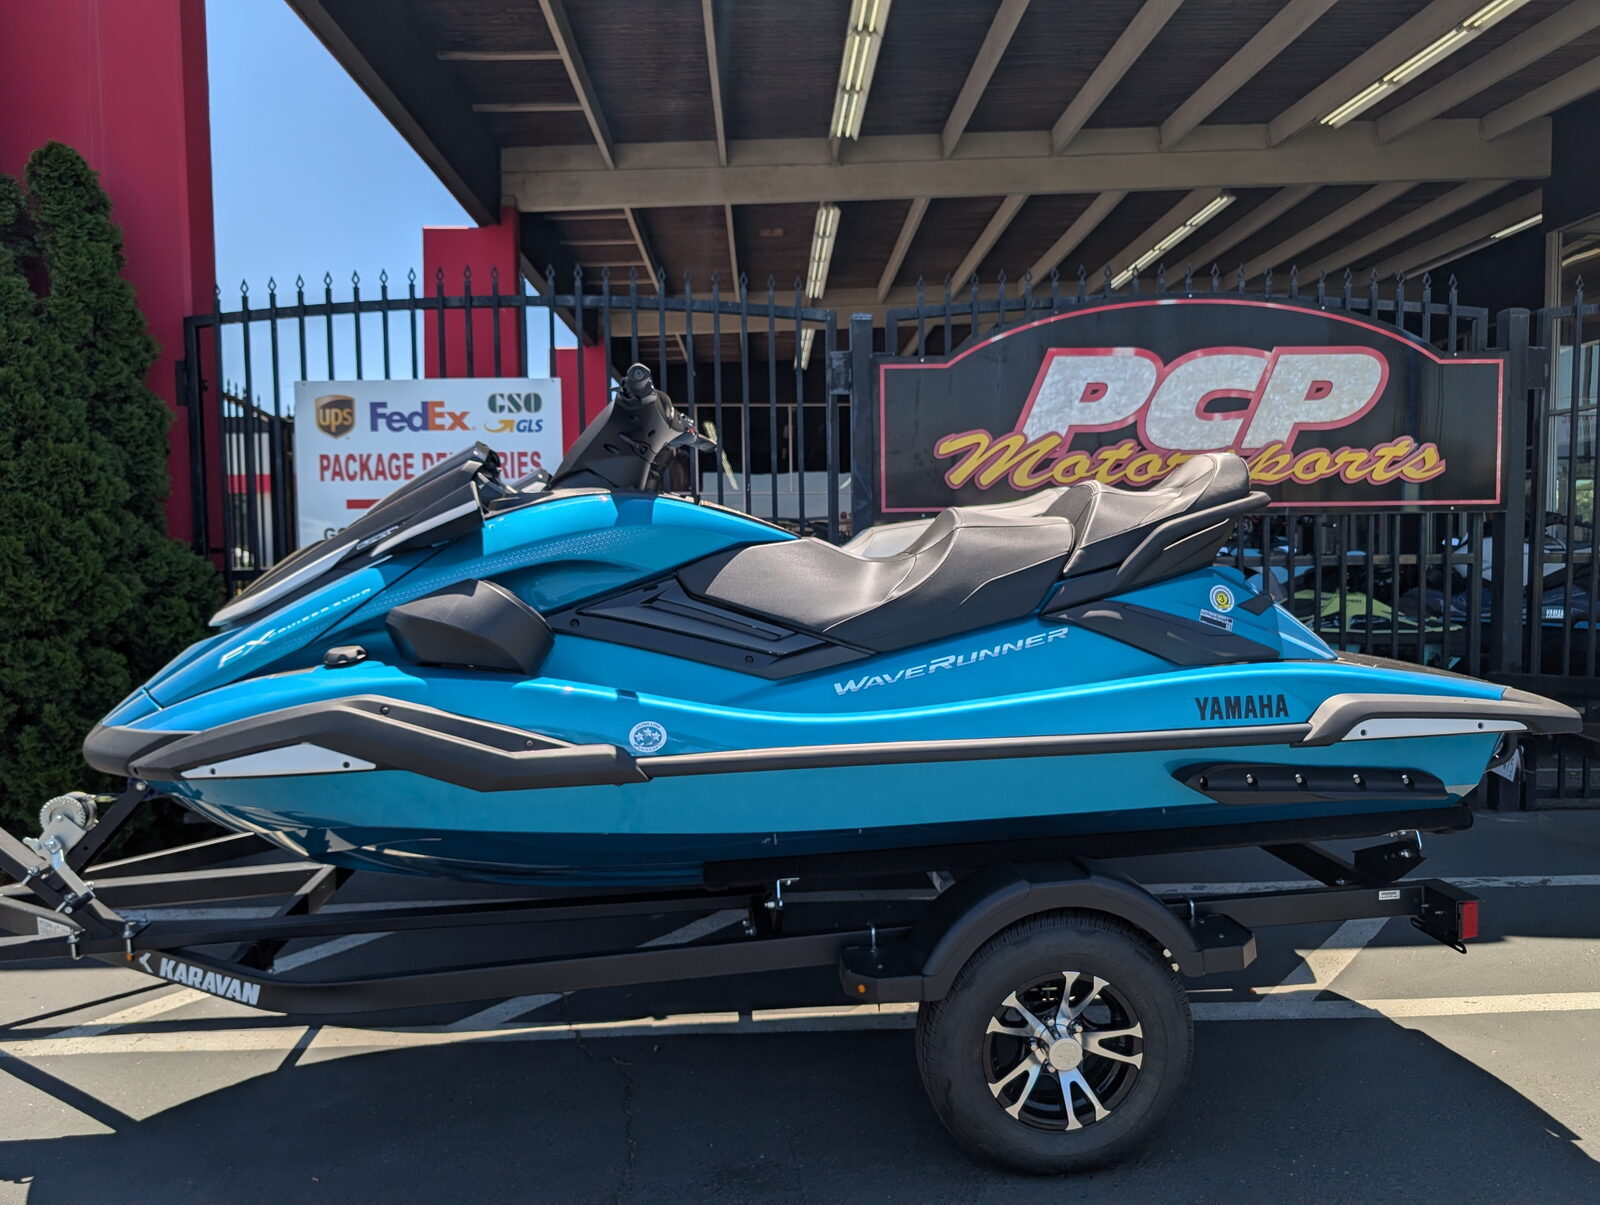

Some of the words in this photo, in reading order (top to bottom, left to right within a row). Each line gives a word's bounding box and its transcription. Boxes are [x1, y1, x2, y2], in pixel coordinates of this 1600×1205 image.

[487, 392, 543, 414] GSO
[1013, 346, 1390, 456] PCP
[319, 407, 353, 433] ups
[369, 400, 471, 433] FedEx
[516, 419, 544, 433] GLS
[319, 452, 416, 482] PACKAGE
[934, 429, 1446, 492] Motorports
[1194, 693, 1290, 721] YAMAHA
[158, 956, 262, 1007] KARAVAN
